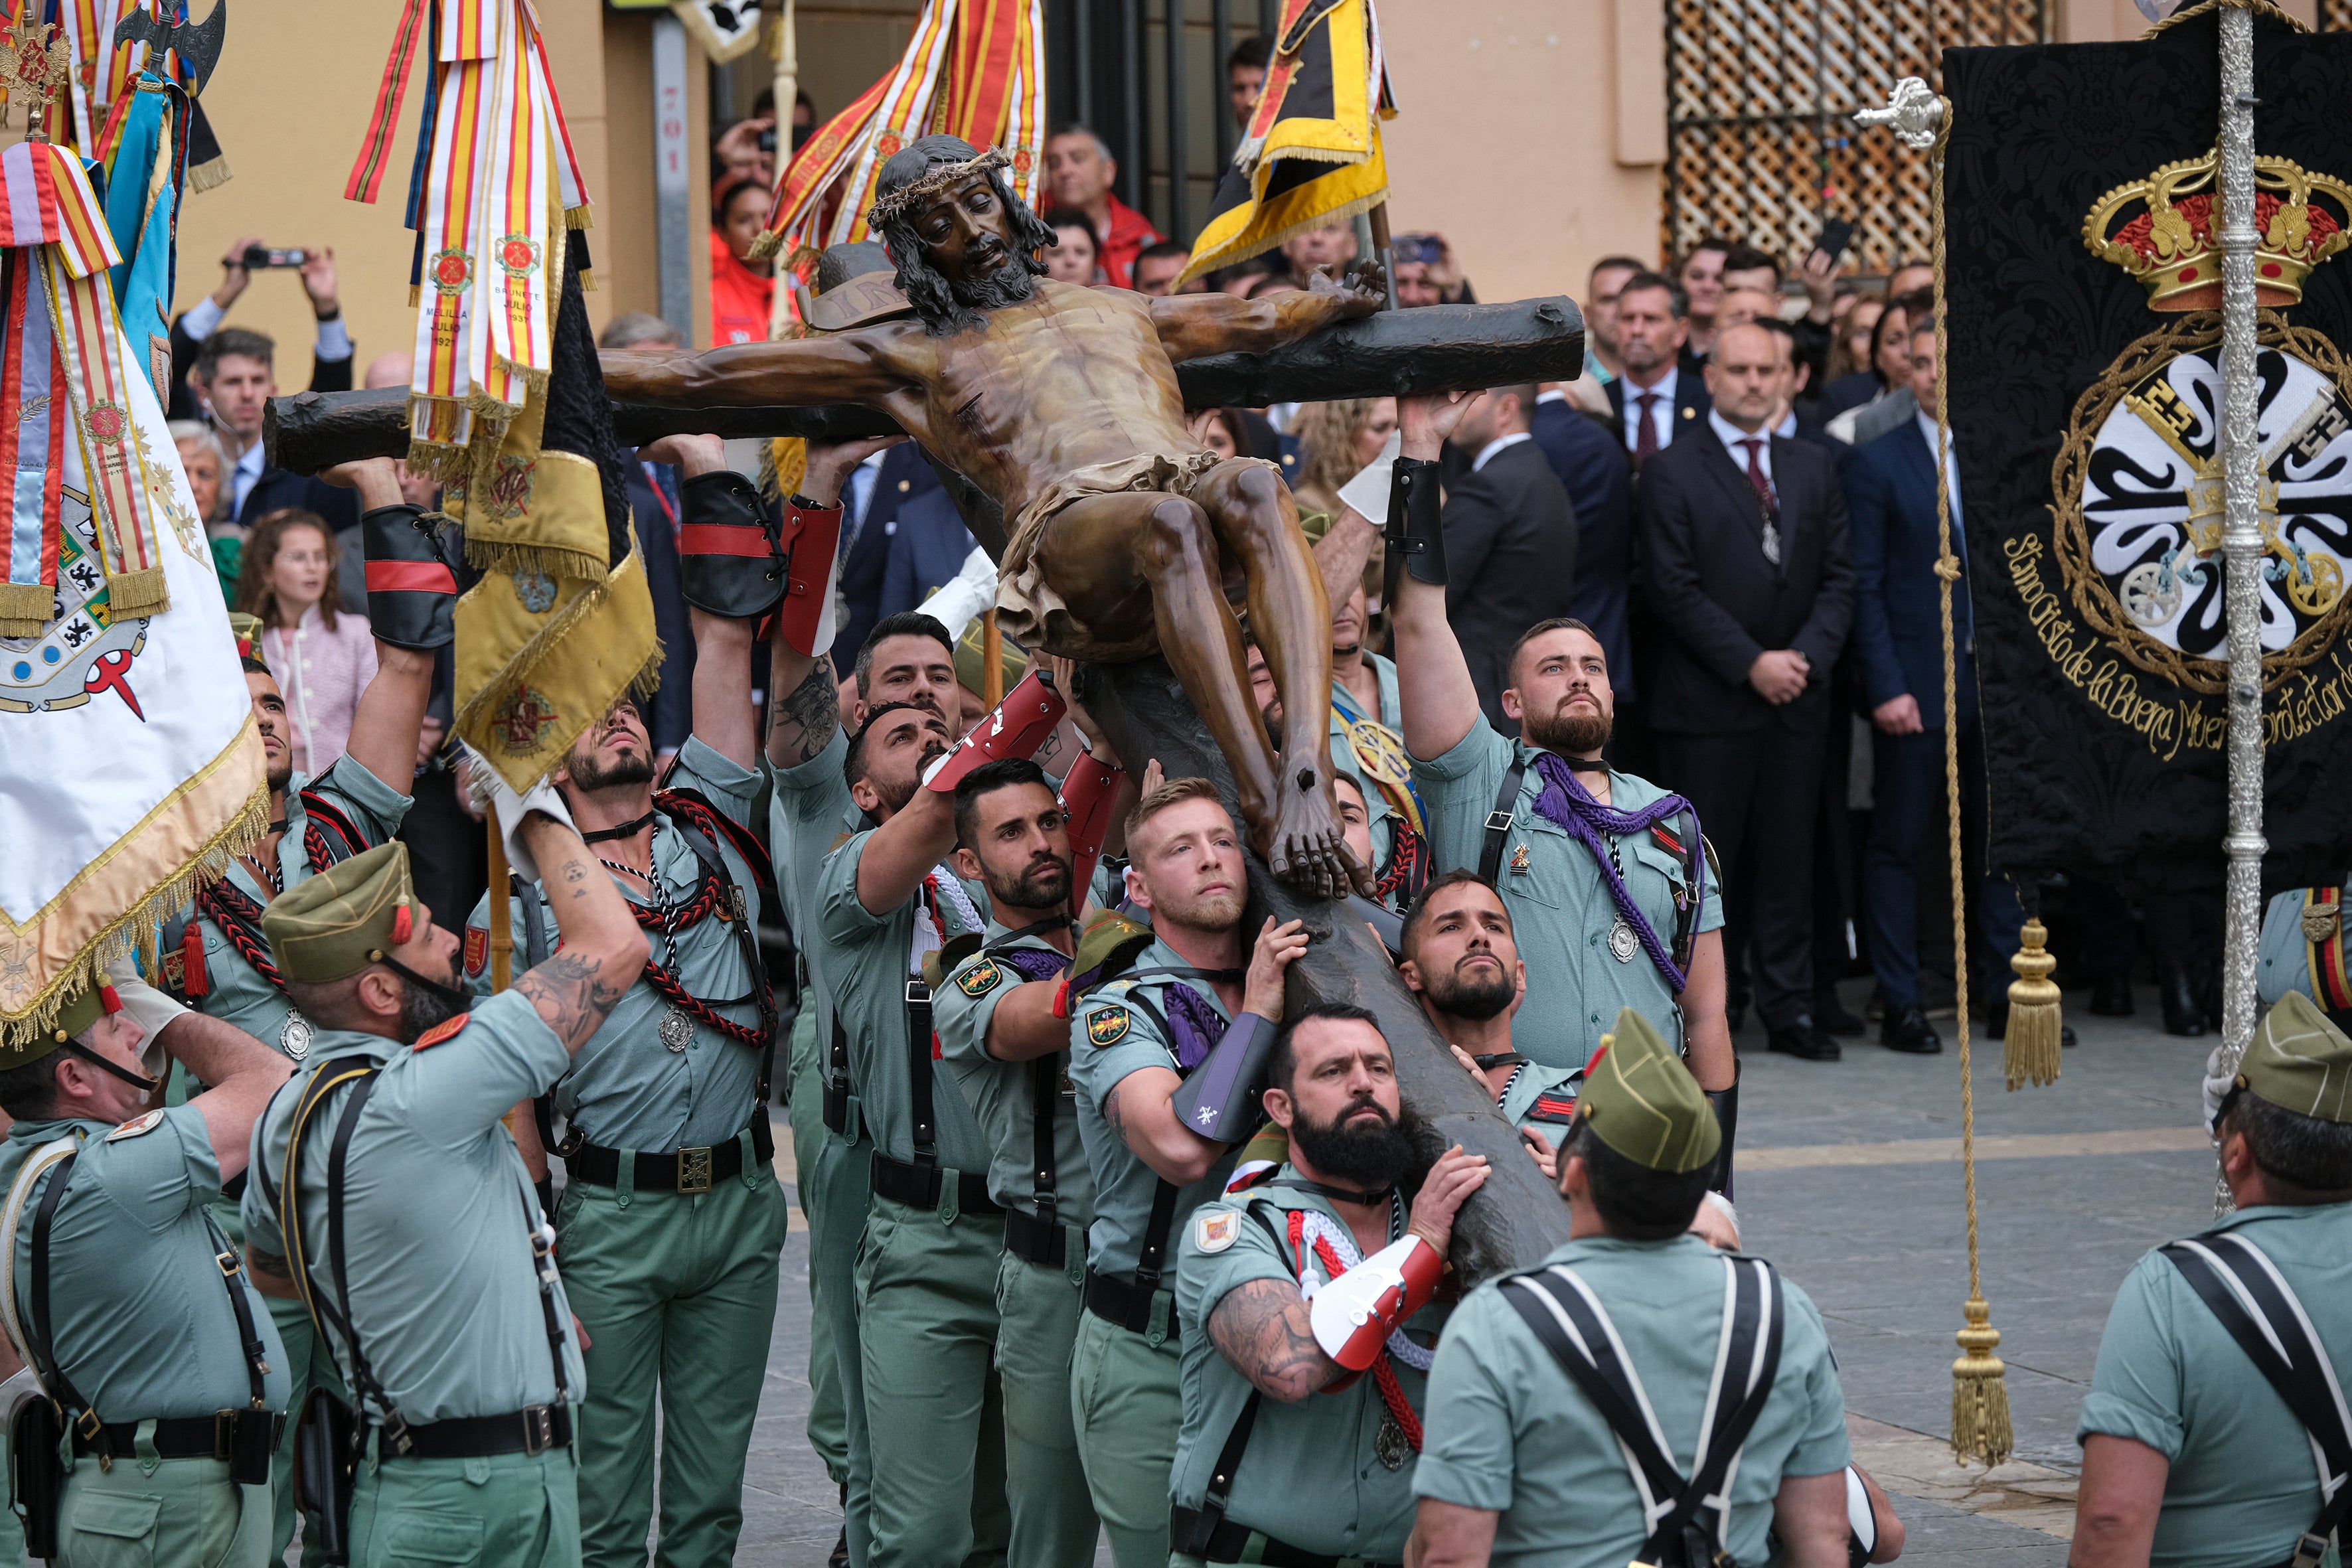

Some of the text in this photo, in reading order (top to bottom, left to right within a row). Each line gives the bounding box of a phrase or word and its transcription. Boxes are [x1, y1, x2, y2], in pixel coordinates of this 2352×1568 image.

[495, 286, 541, 301] BRUNETE
[830, 278, 908, 320] IN
[504, 300, 533, 312] JULIO
[426, 307, 468, 319] MELILLA
[509, 314, 528, 324] 1937
[430, 322, 461, 333] JULIO
[434, 337, 456, 347] 1921
[2028, 592, 2076, 663] Cristo
[2062, 636, 2100, 687] de
[2087, 659, 2119, 710] la
[2106, 673, 2175, 753] Buena
[2163, 698, 2229, 762] Muer
